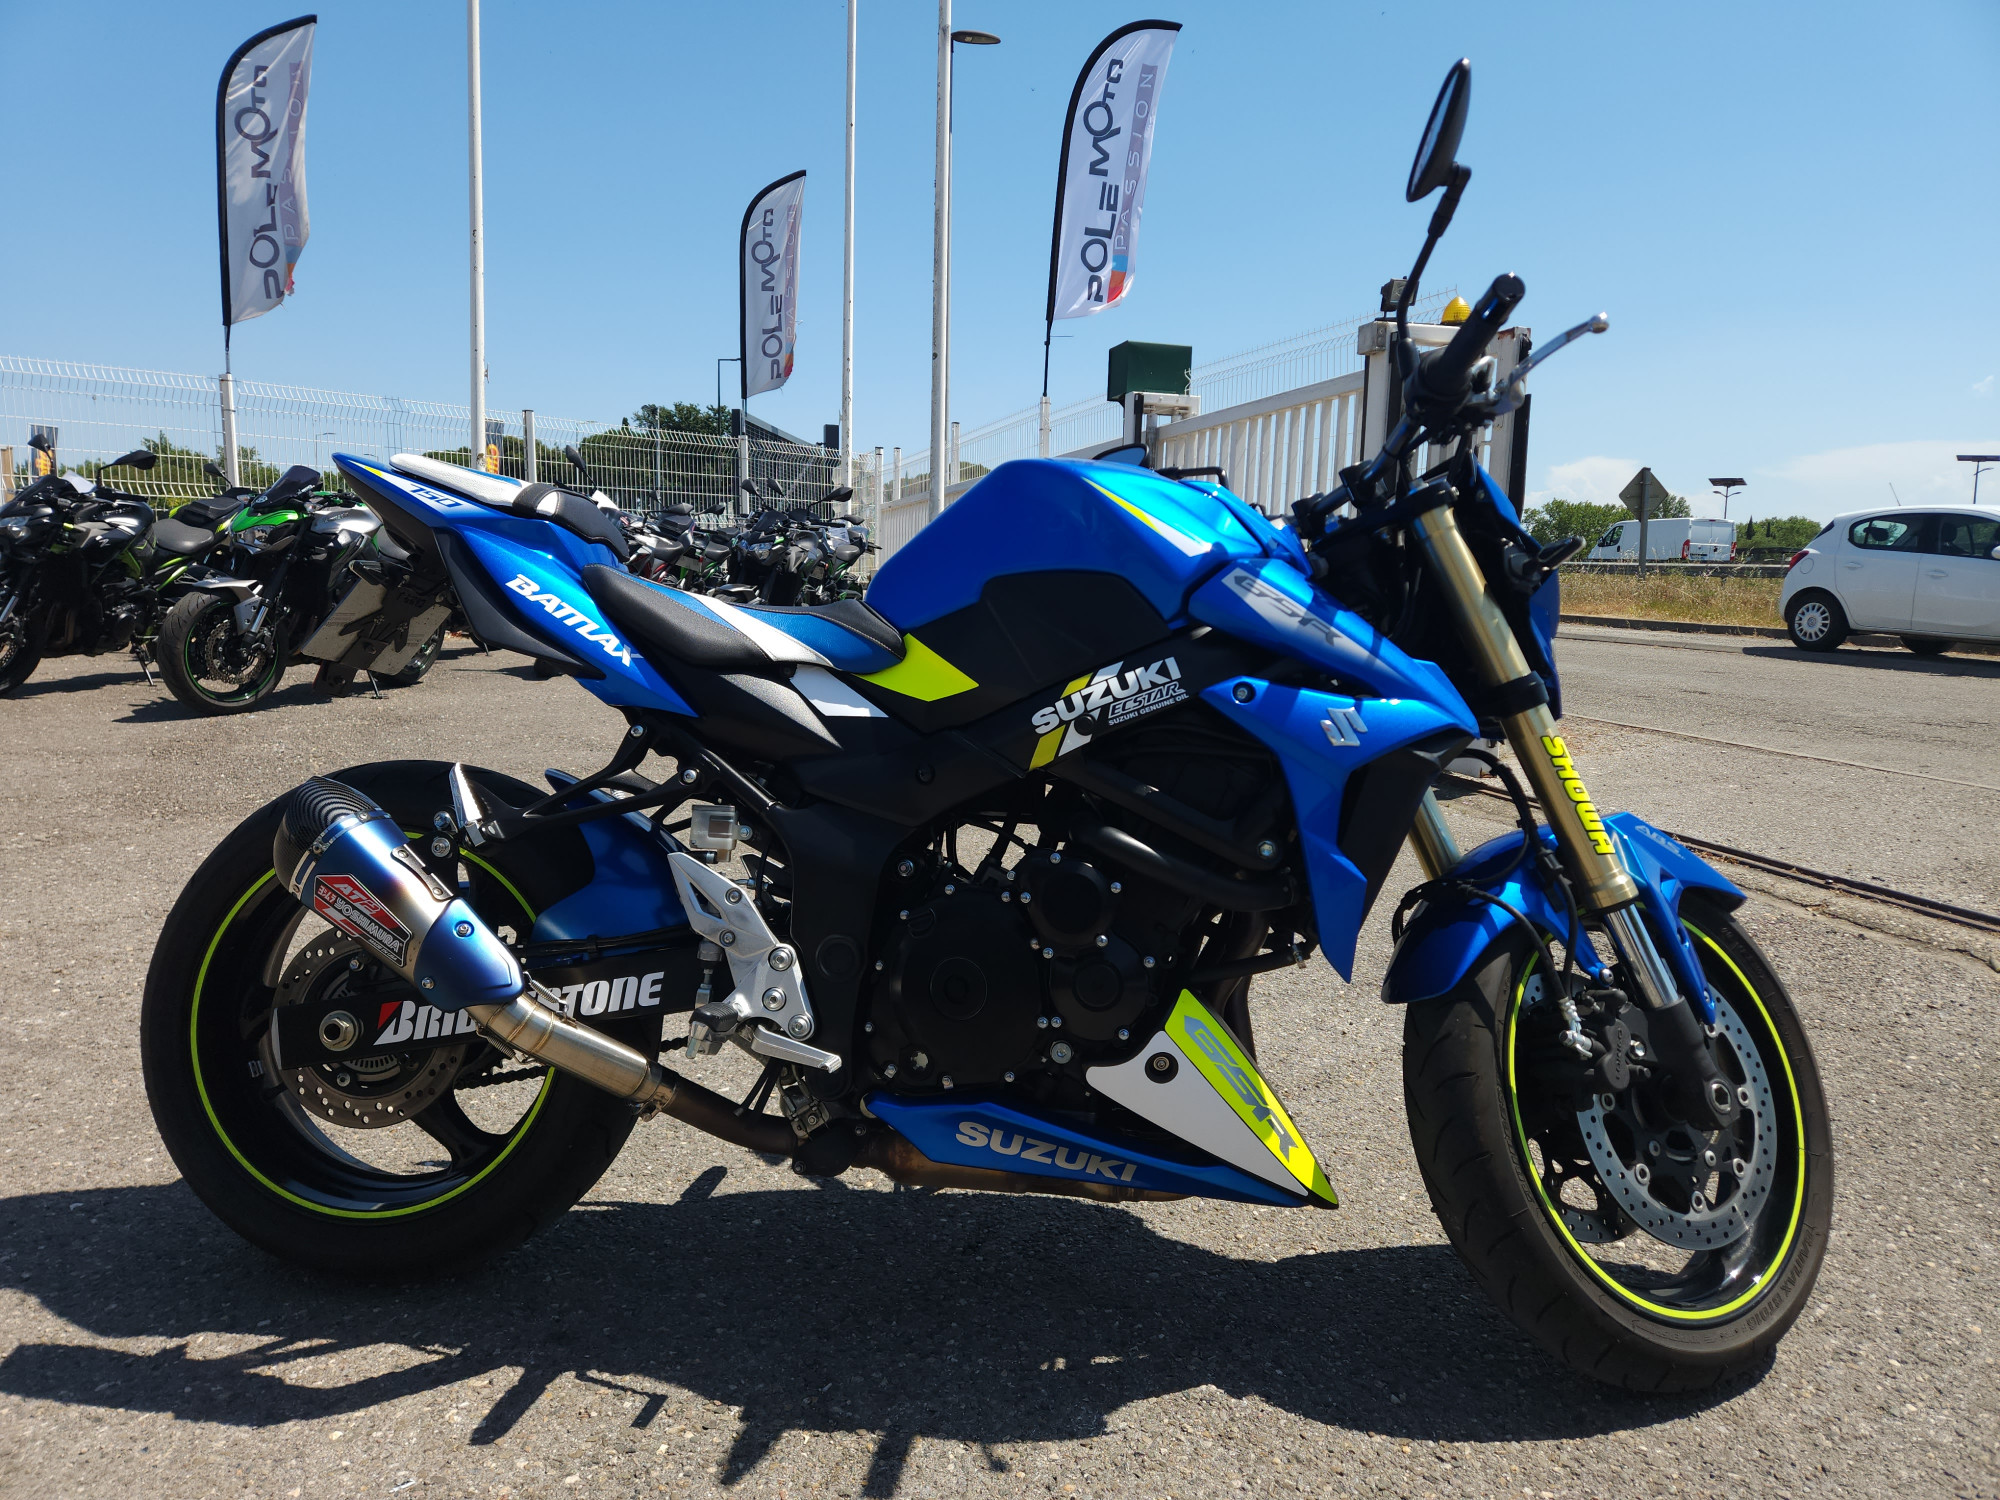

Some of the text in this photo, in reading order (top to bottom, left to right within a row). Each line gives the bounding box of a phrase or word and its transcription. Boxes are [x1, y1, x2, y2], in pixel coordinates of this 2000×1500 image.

[1113, 72, 1155, 251] PASSION
[786, 210, 797, 340] PASSION
[1080, 181, 1120, 303] POLE
[761, 294, 783, 380] POLE
[410, 483, 463, 508] 750
[505, 574, 643, 668] BATTLAX
[1031, 656, 1182, 735] SUZUKI
[1108, 681, 1186, 719] ECSTAR
[1108, 693, 1189, 726] SUZUKI GENUINE OIL
[1540, 735, 1616, 856] SHOWA
[334, 897, 400, 953] YOSHIMURA
[1184, 1015, 1299, 1163] GSR
[956, 1121, 1138, 1182] SUZUKI
